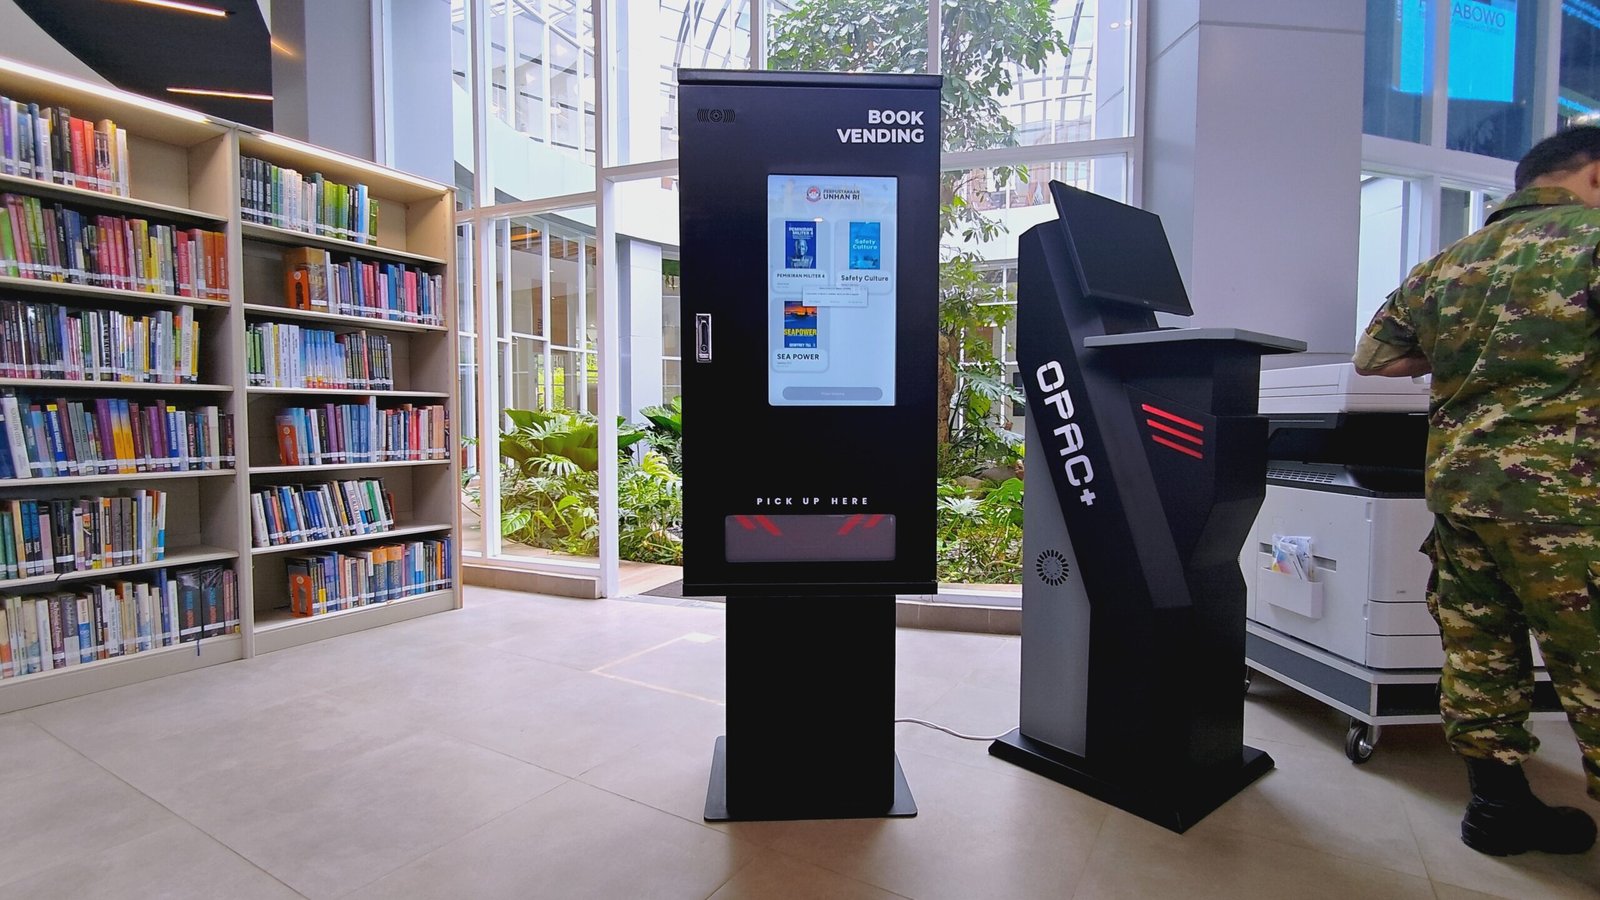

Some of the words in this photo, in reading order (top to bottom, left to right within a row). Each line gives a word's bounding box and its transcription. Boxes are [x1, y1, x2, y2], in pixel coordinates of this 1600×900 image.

[1452, 1, 1506, 28] ABOWO
[868, 109, 925, 125] BOOK
[836, 128, 925, 143] VENDING
[841, 274, 863, 283] Safety
[784, 328, 817, 337] SEAPOWER
[793, 353, 820, 361] POWER
[1036, 360, 1097, 506] OPAC+
[756, 497, 793, 505] PICK
[802, 497, 820, 505] UP
[831, 497, 868, 505] HERE
